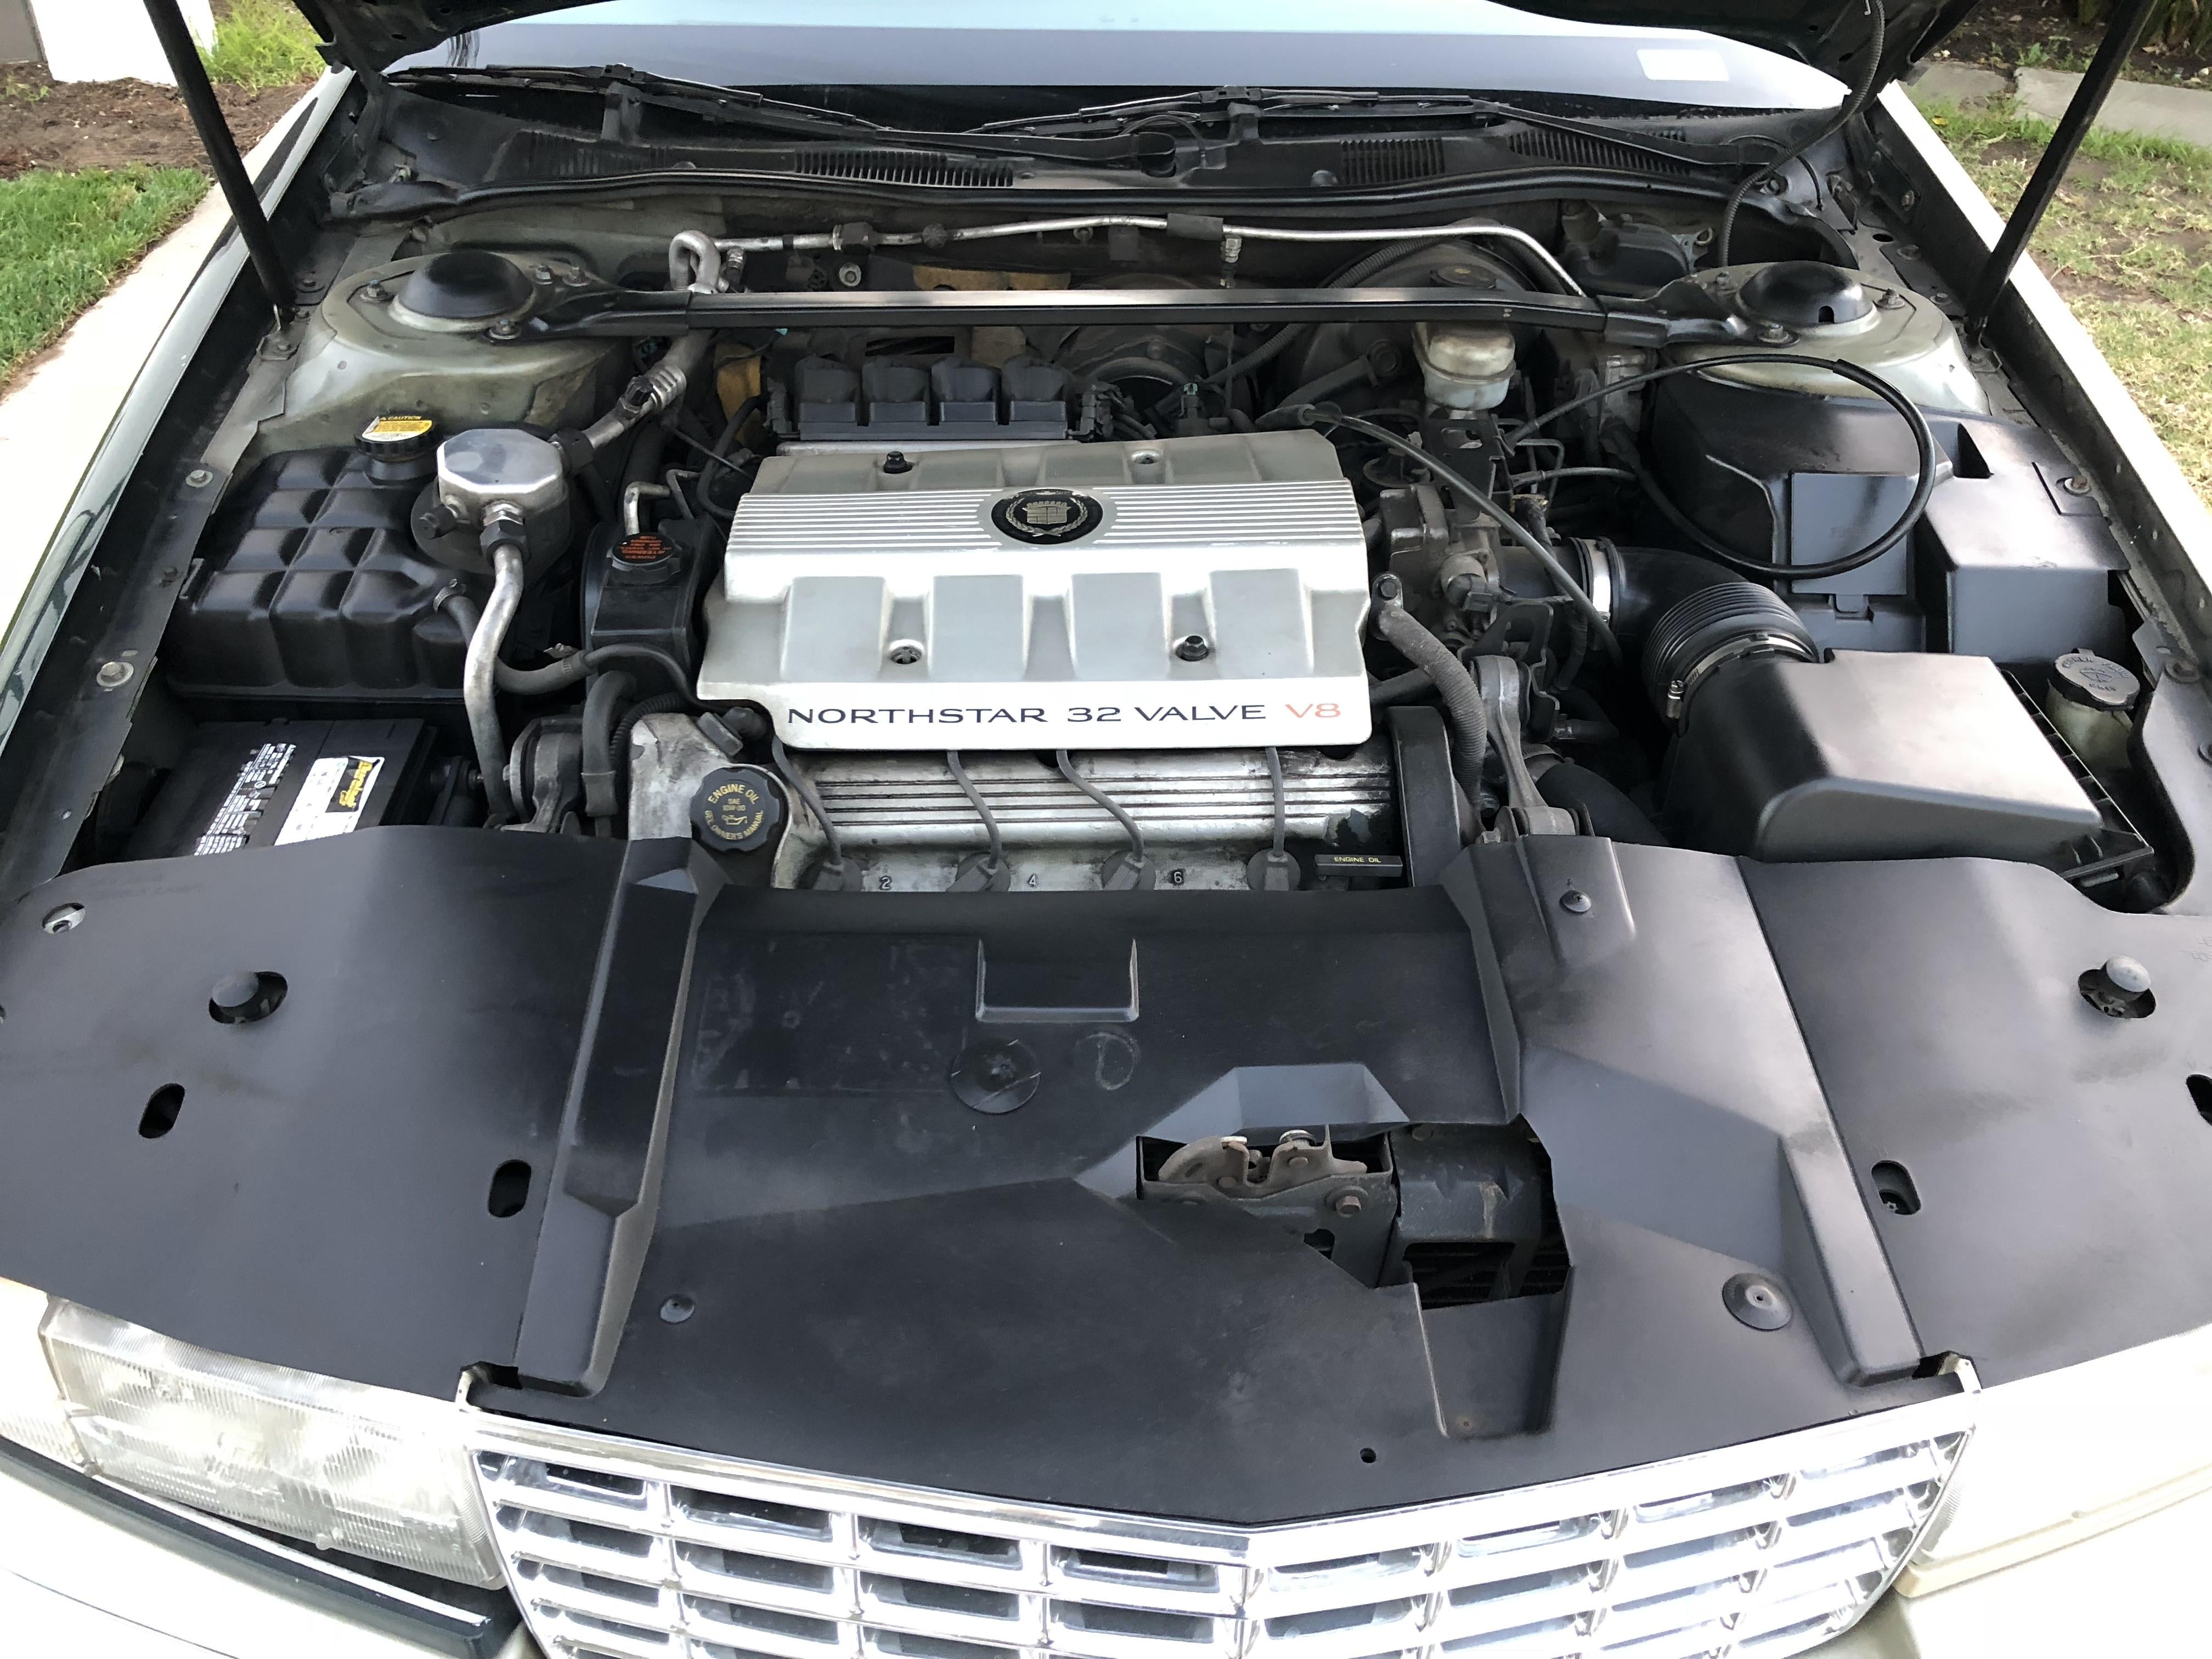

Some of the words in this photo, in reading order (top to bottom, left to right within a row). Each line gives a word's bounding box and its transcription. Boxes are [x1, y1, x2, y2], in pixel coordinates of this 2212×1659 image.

[788, 708, 1048, 724] NORTHSTAR
[1067, 707, 1121, 722] 32
[1133, 705, 1266, 721] VALVE
[1284, 703, 1341, 718] V8
[707, 783, 746, 804] ENGINE
[745, 789, 760, 805] OIL
[743, 810, 764, 837] MANUAL
[881, 877, 891, 890] 2
[1028, 874, 1037, 887] 4
[1173, 872, 1183, 883] 6
